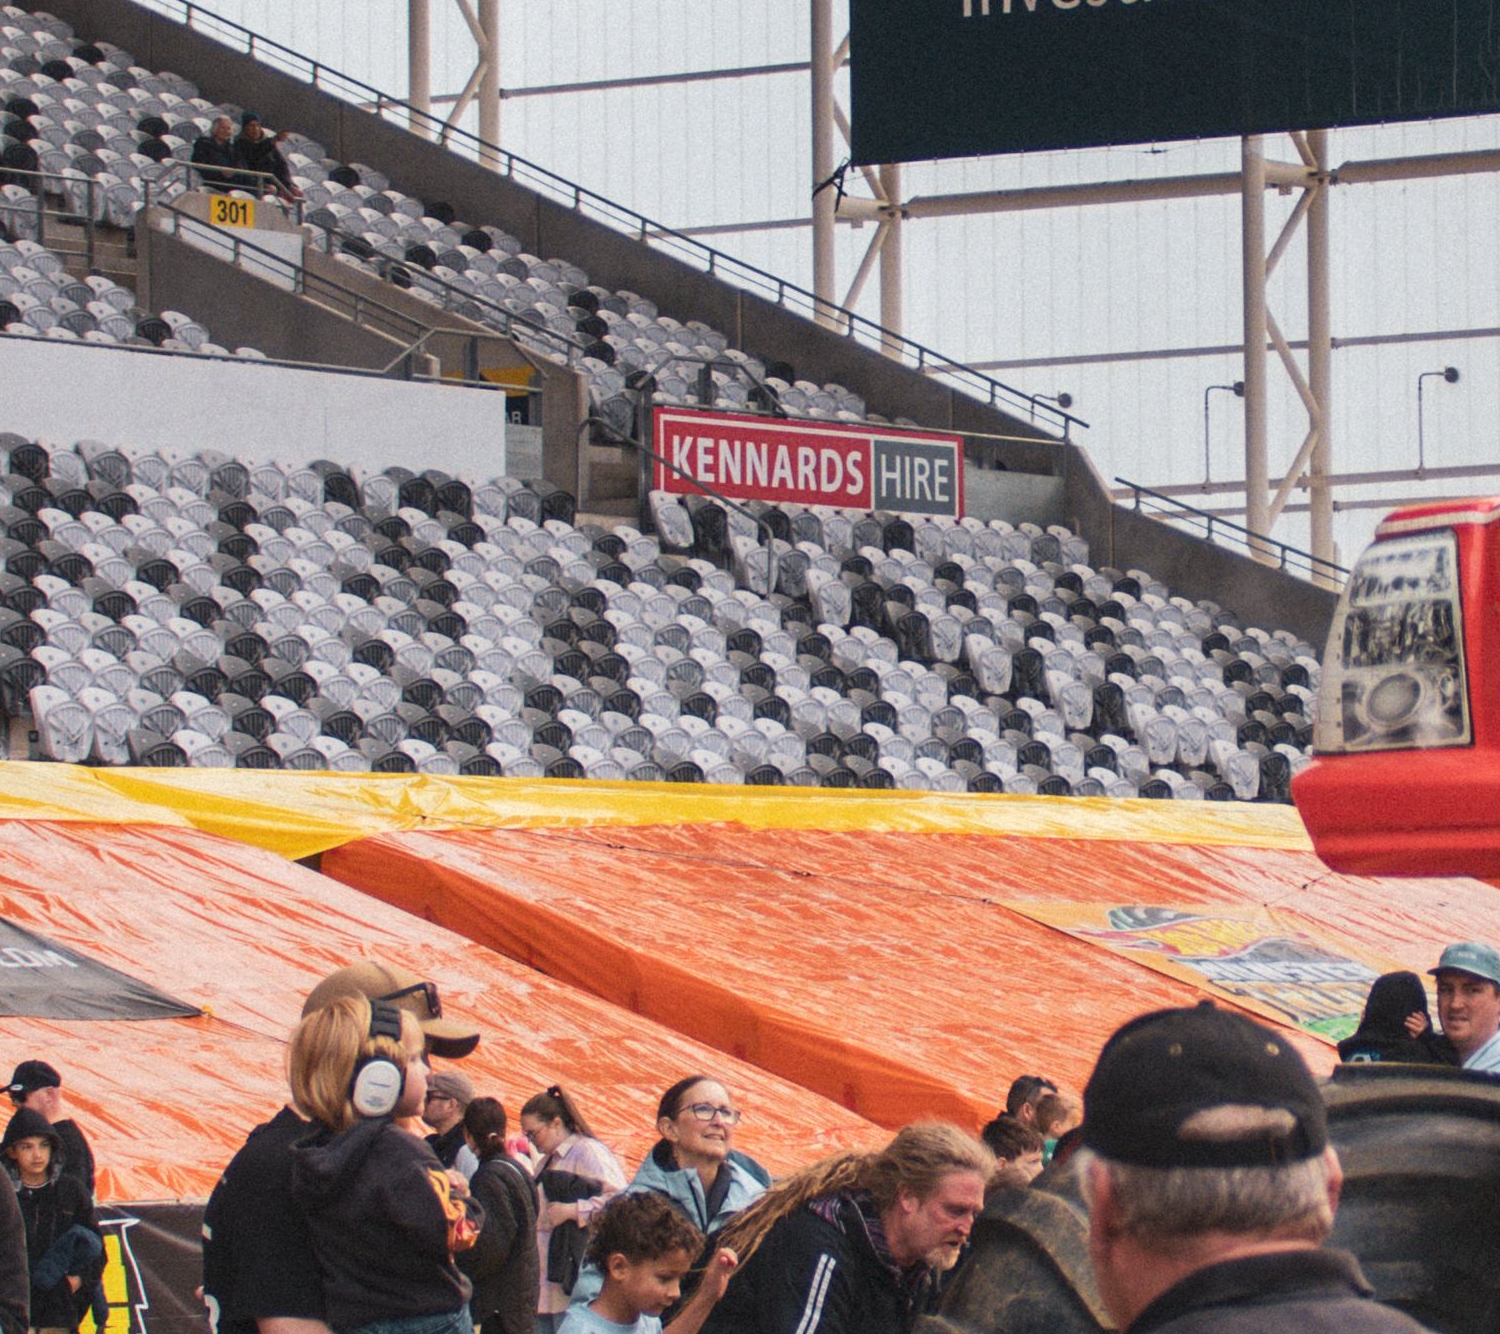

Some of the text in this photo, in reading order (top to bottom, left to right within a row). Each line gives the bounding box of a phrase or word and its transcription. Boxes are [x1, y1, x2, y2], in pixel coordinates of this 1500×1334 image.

[216, 199, 248, 225] 301
[671, 434, 950, 503] KENNARDS HIRE
